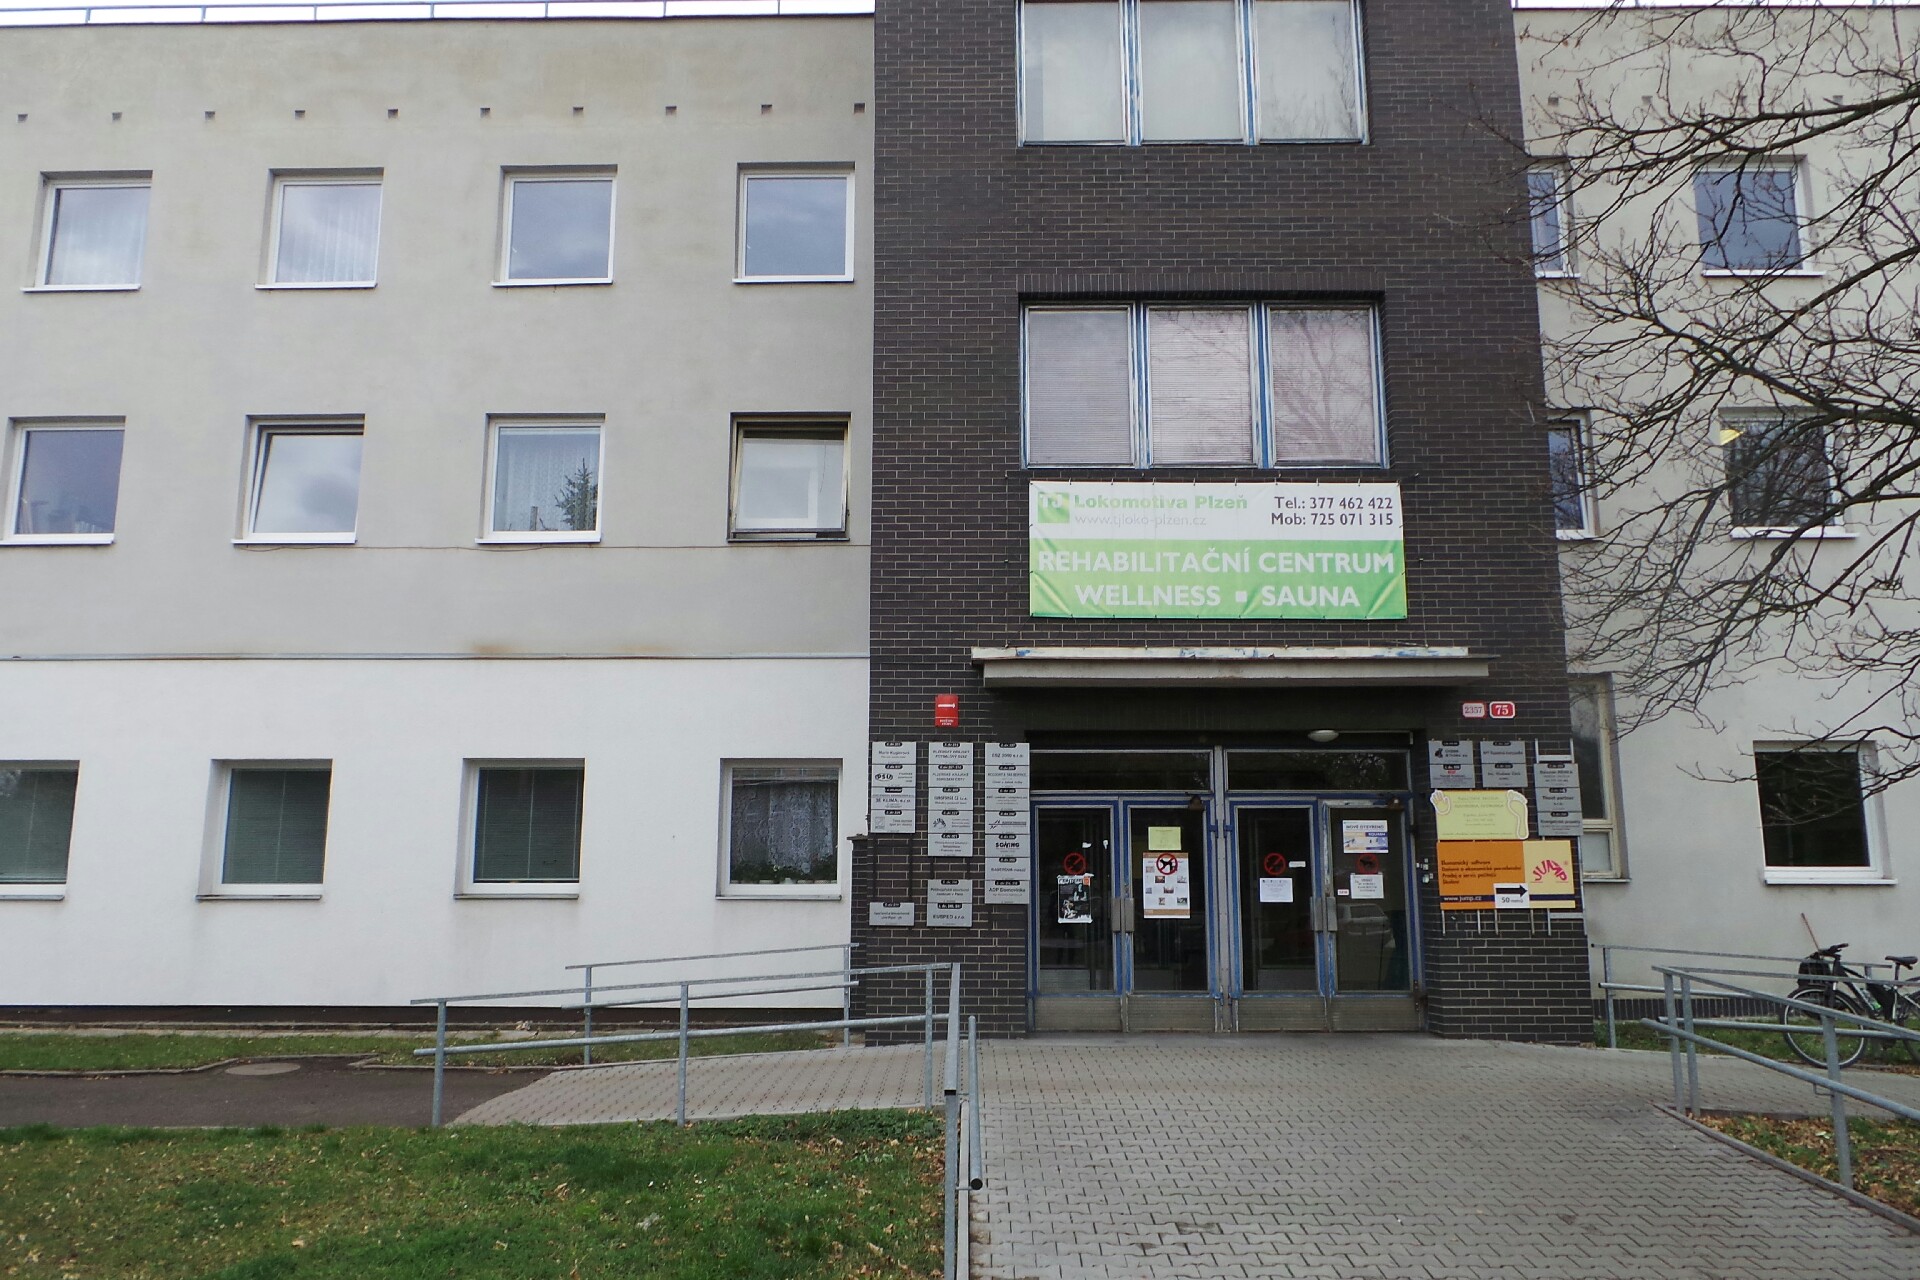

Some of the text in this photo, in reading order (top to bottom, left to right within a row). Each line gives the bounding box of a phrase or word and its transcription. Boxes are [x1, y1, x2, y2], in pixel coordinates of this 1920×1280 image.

[1074, 494, 1248, 510] Lokomotiva Plzeň
[1274, 496, 1393, 510] Tel.: 377 462 422
[1271, 512, 1393, 526] Mob: 725 071 315
[1038, 547, 1394, 574] REHABILITAČNÍ CENTRUM
[1074, 584, 1361, 608] WELLNESS SAUNA
[1464, 706, 1483, 714] 2357
[1495, 704, 1509, 716] 75
[1532, 859, 1568, 882] JUMP
